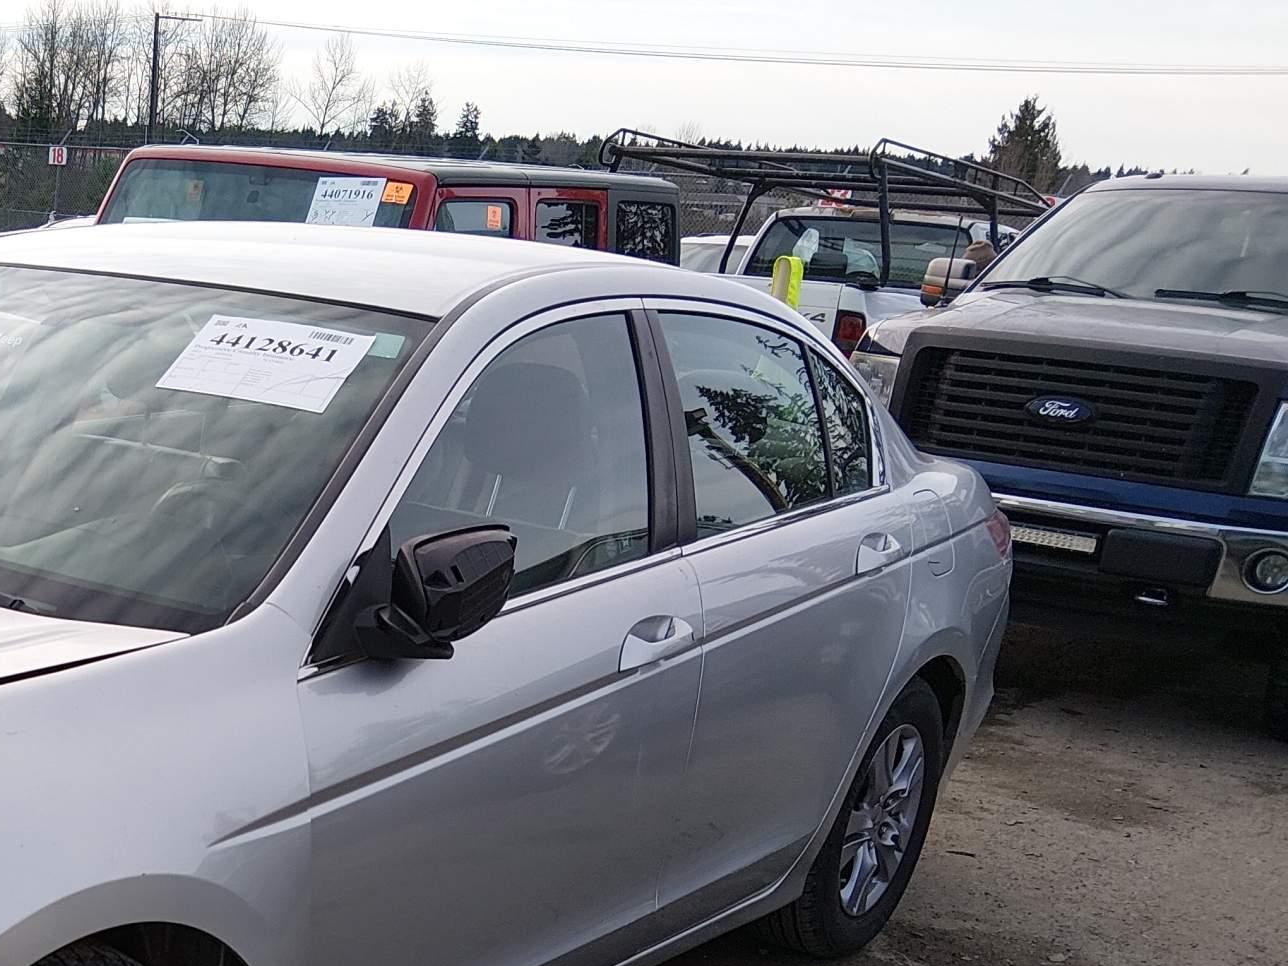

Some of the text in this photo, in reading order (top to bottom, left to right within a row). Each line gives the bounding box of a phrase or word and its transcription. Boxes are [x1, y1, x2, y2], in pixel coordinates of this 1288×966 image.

[52, 147, 64, 164] 18
[321, 189, 374, 200] 44071916
[210, 332, 338, 362] 44128641
[1039, 400, 1080, 419] Ford
